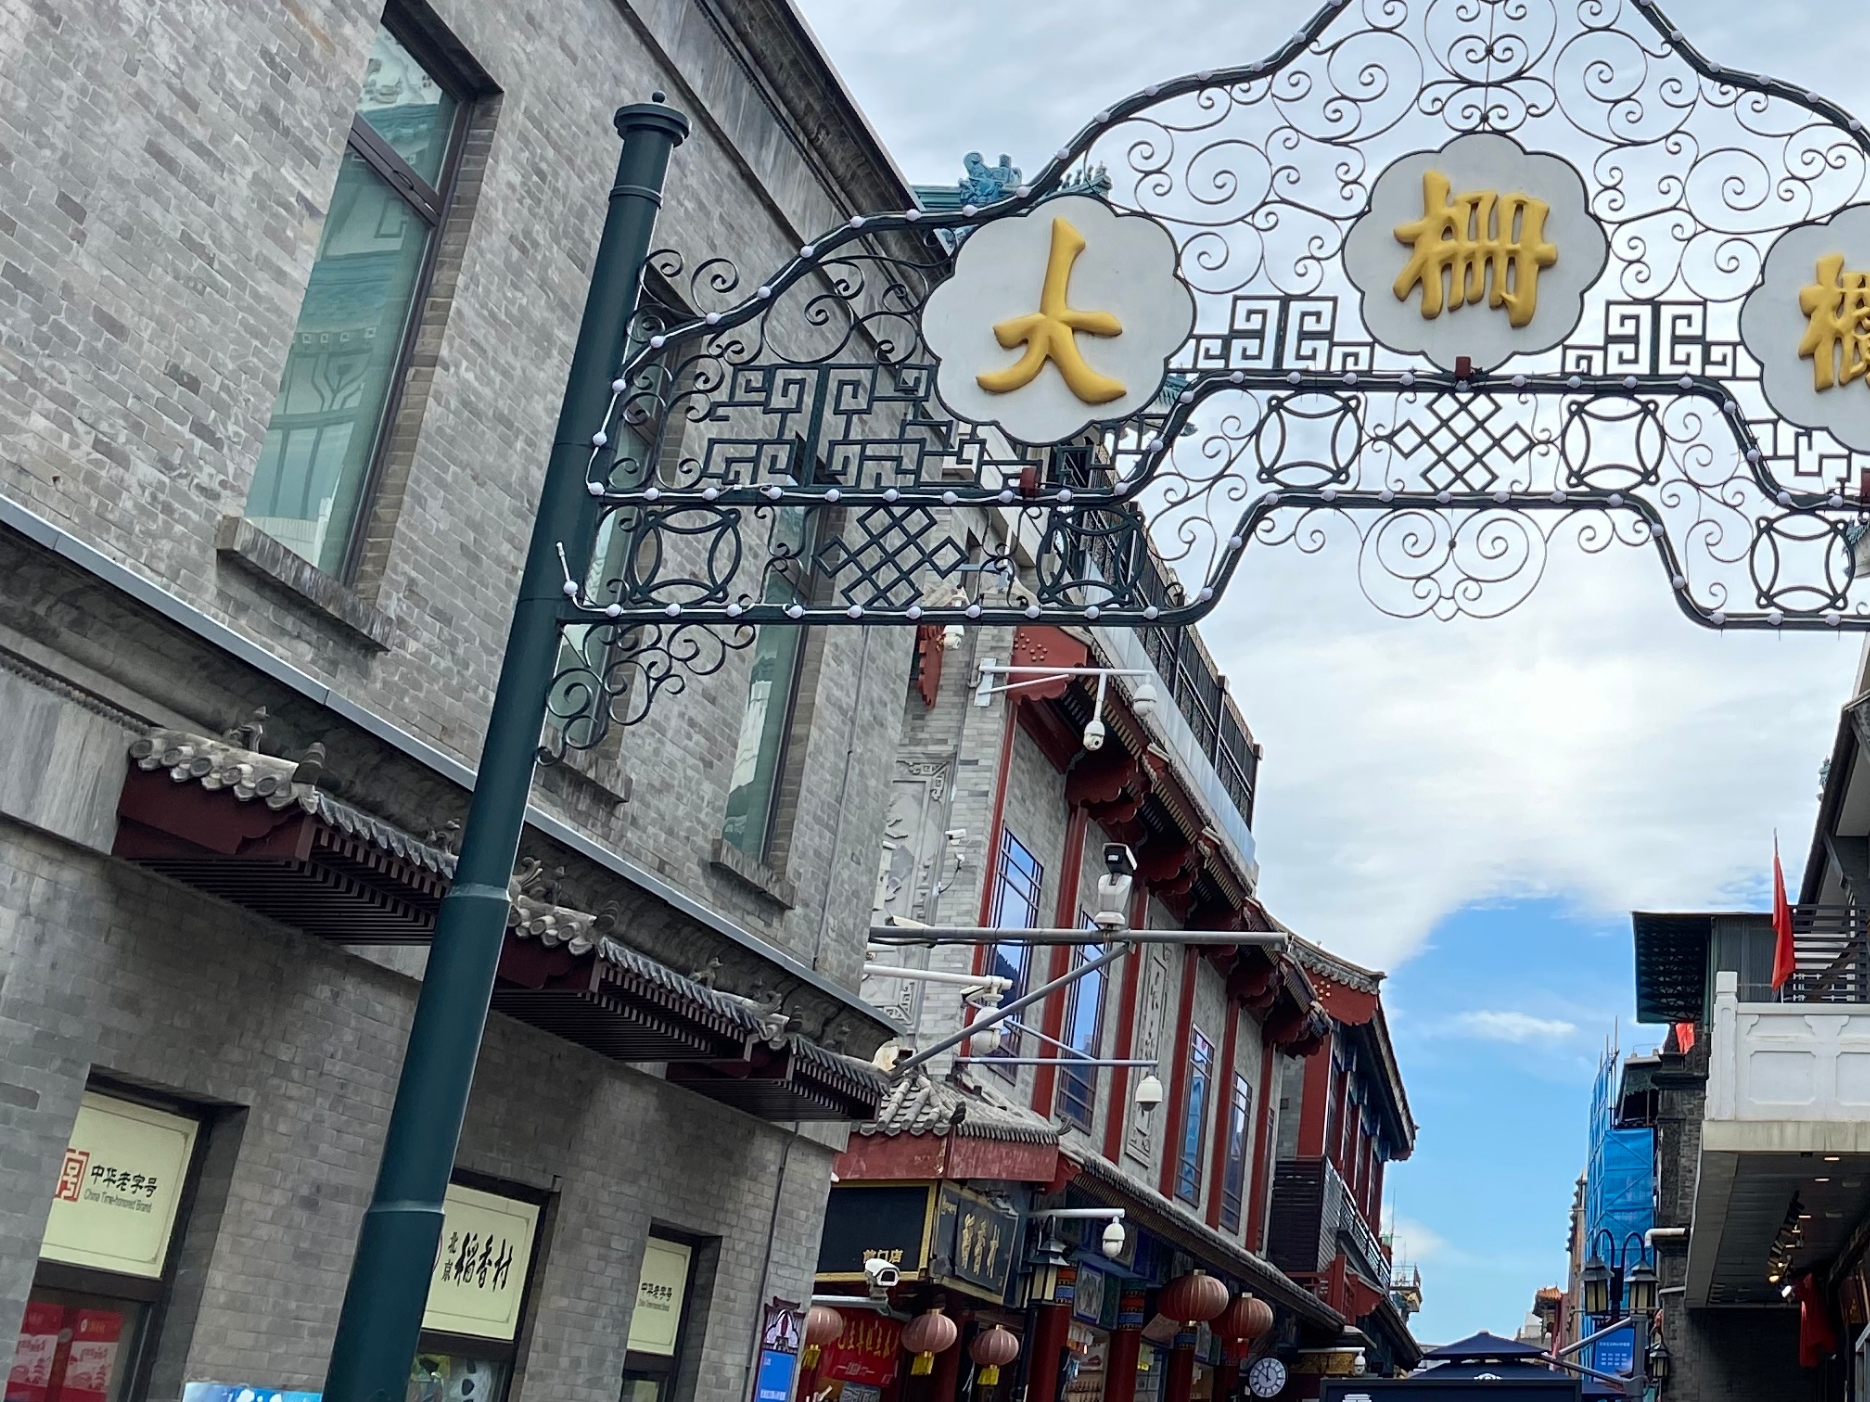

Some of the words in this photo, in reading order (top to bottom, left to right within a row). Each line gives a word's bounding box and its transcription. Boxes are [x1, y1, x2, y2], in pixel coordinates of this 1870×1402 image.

[90, 1164, 158, 1198] 中华老字号
[441, 1231, 459, 1282] 北京
[454, 1231, 514, 1293] 稻香村
